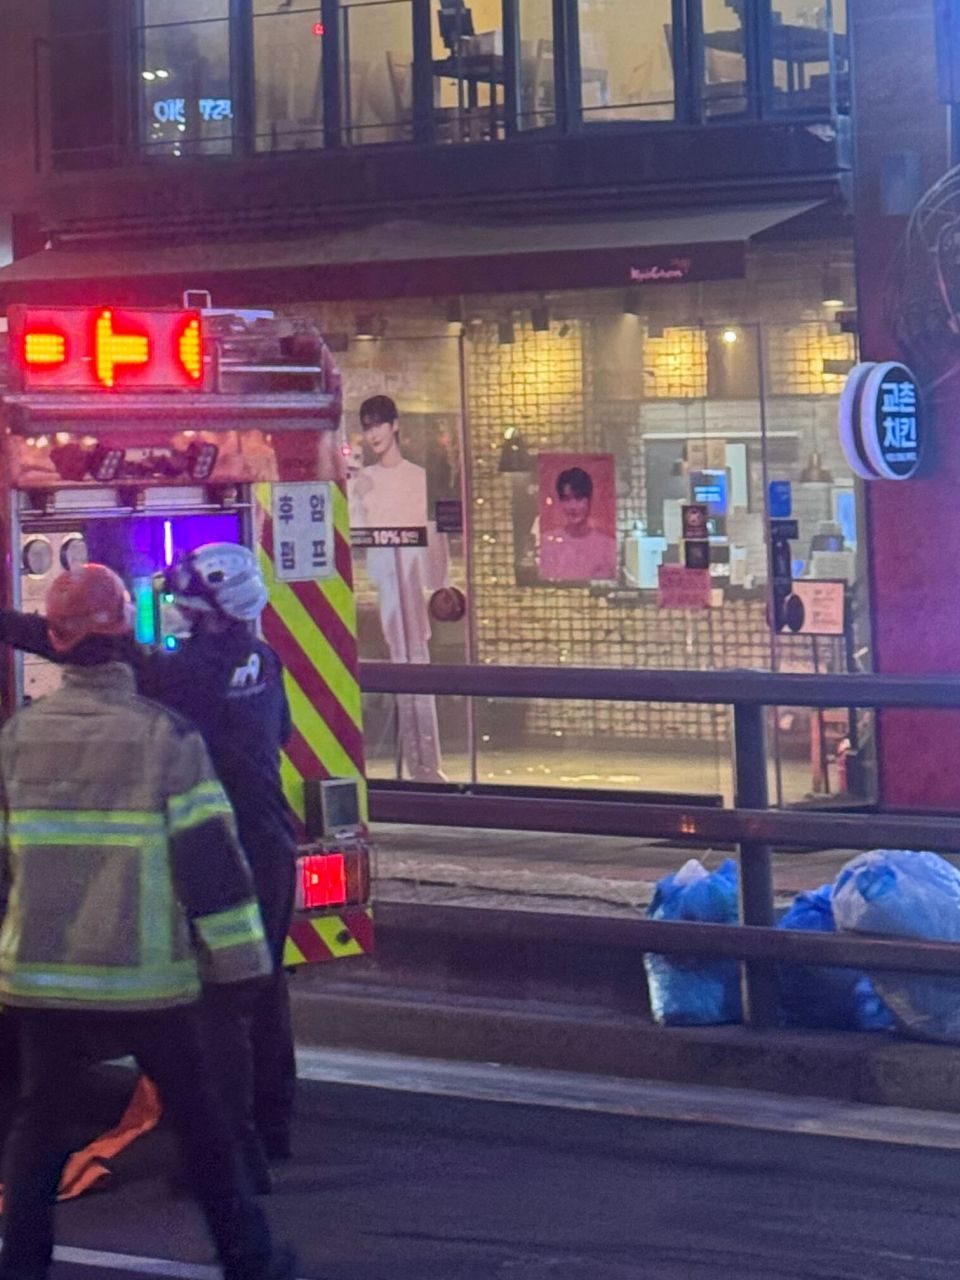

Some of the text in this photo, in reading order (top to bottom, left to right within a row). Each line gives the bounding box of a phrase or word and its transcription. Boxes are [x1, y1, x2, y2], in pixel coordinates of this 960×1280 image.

[881, 382, 916, 413] 교촌
[883, 416, 917, 448] 치킨
[373, 530, 400, 545] 10%
